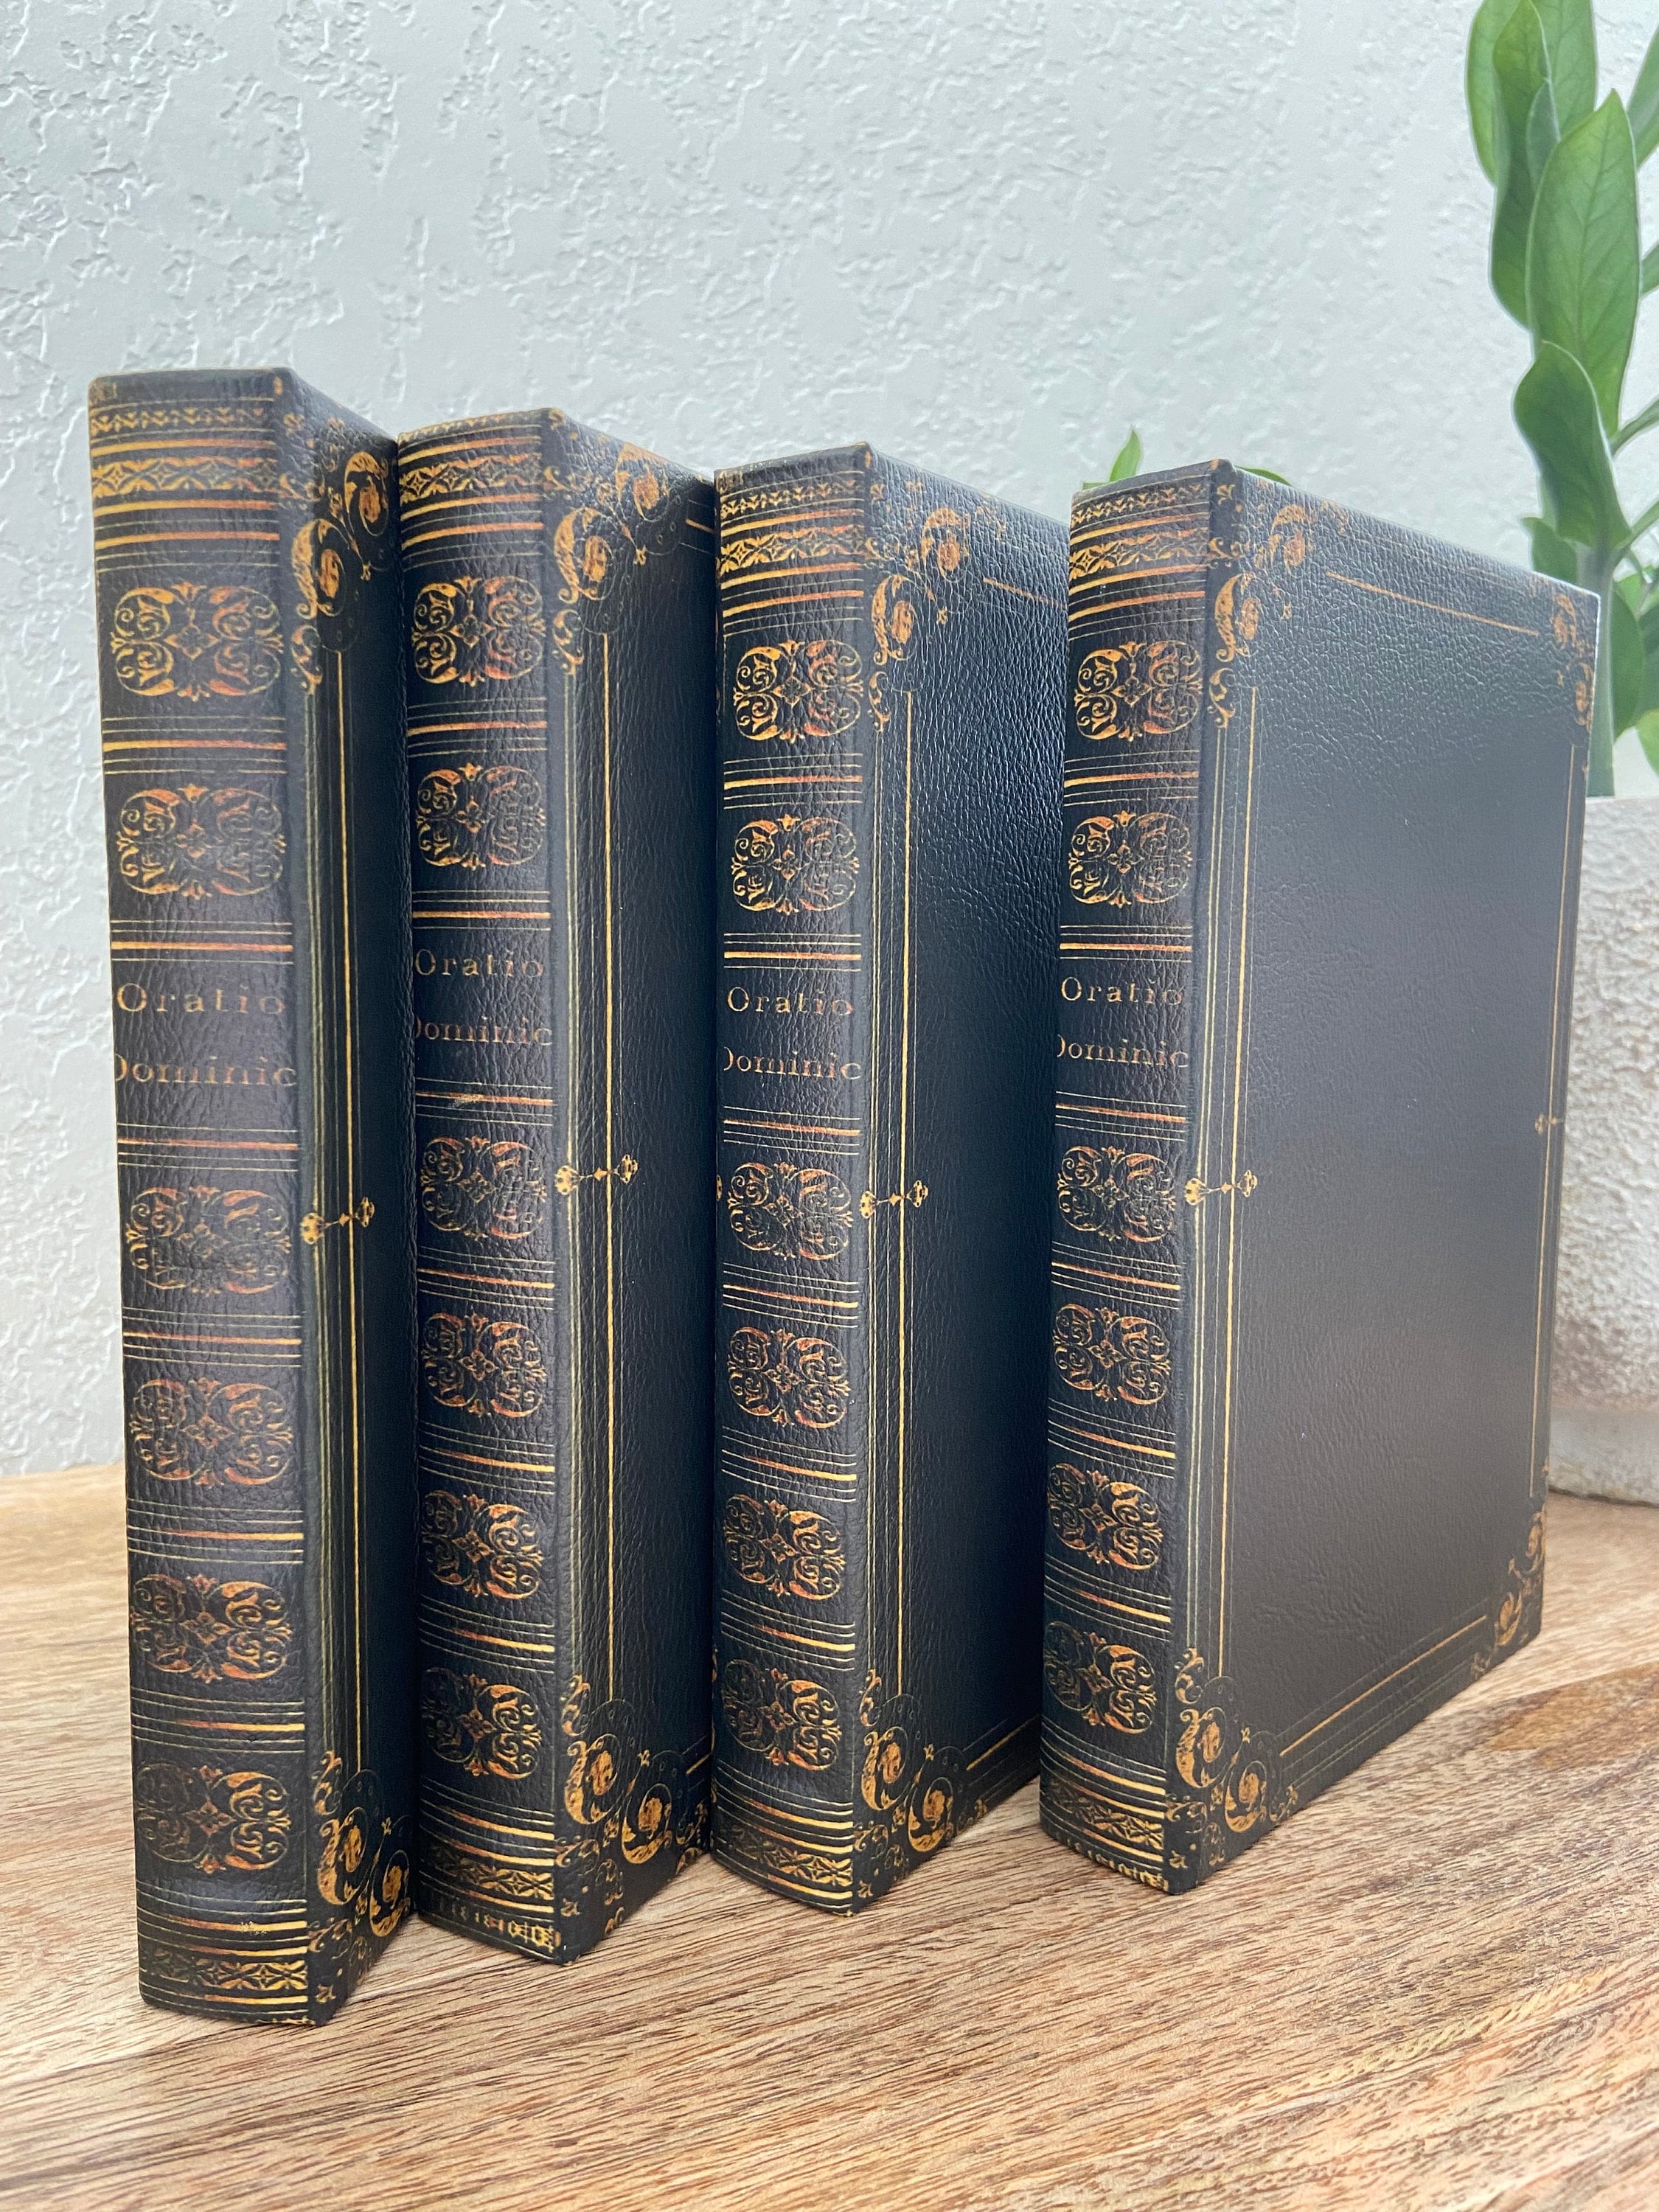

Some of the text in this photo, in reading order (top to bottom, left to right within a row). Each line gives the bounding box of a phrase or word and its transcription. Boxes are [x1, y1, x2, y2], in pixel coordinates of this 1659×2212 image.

[415, 948, 543, 978] Oratio
[116, 983, 285, 1015] Oratio
[727, 987, 854, 1015] Oratio
[1061, 976, 1183, 1005] Oratio
[415, 1015, 552, 1046] ominic
